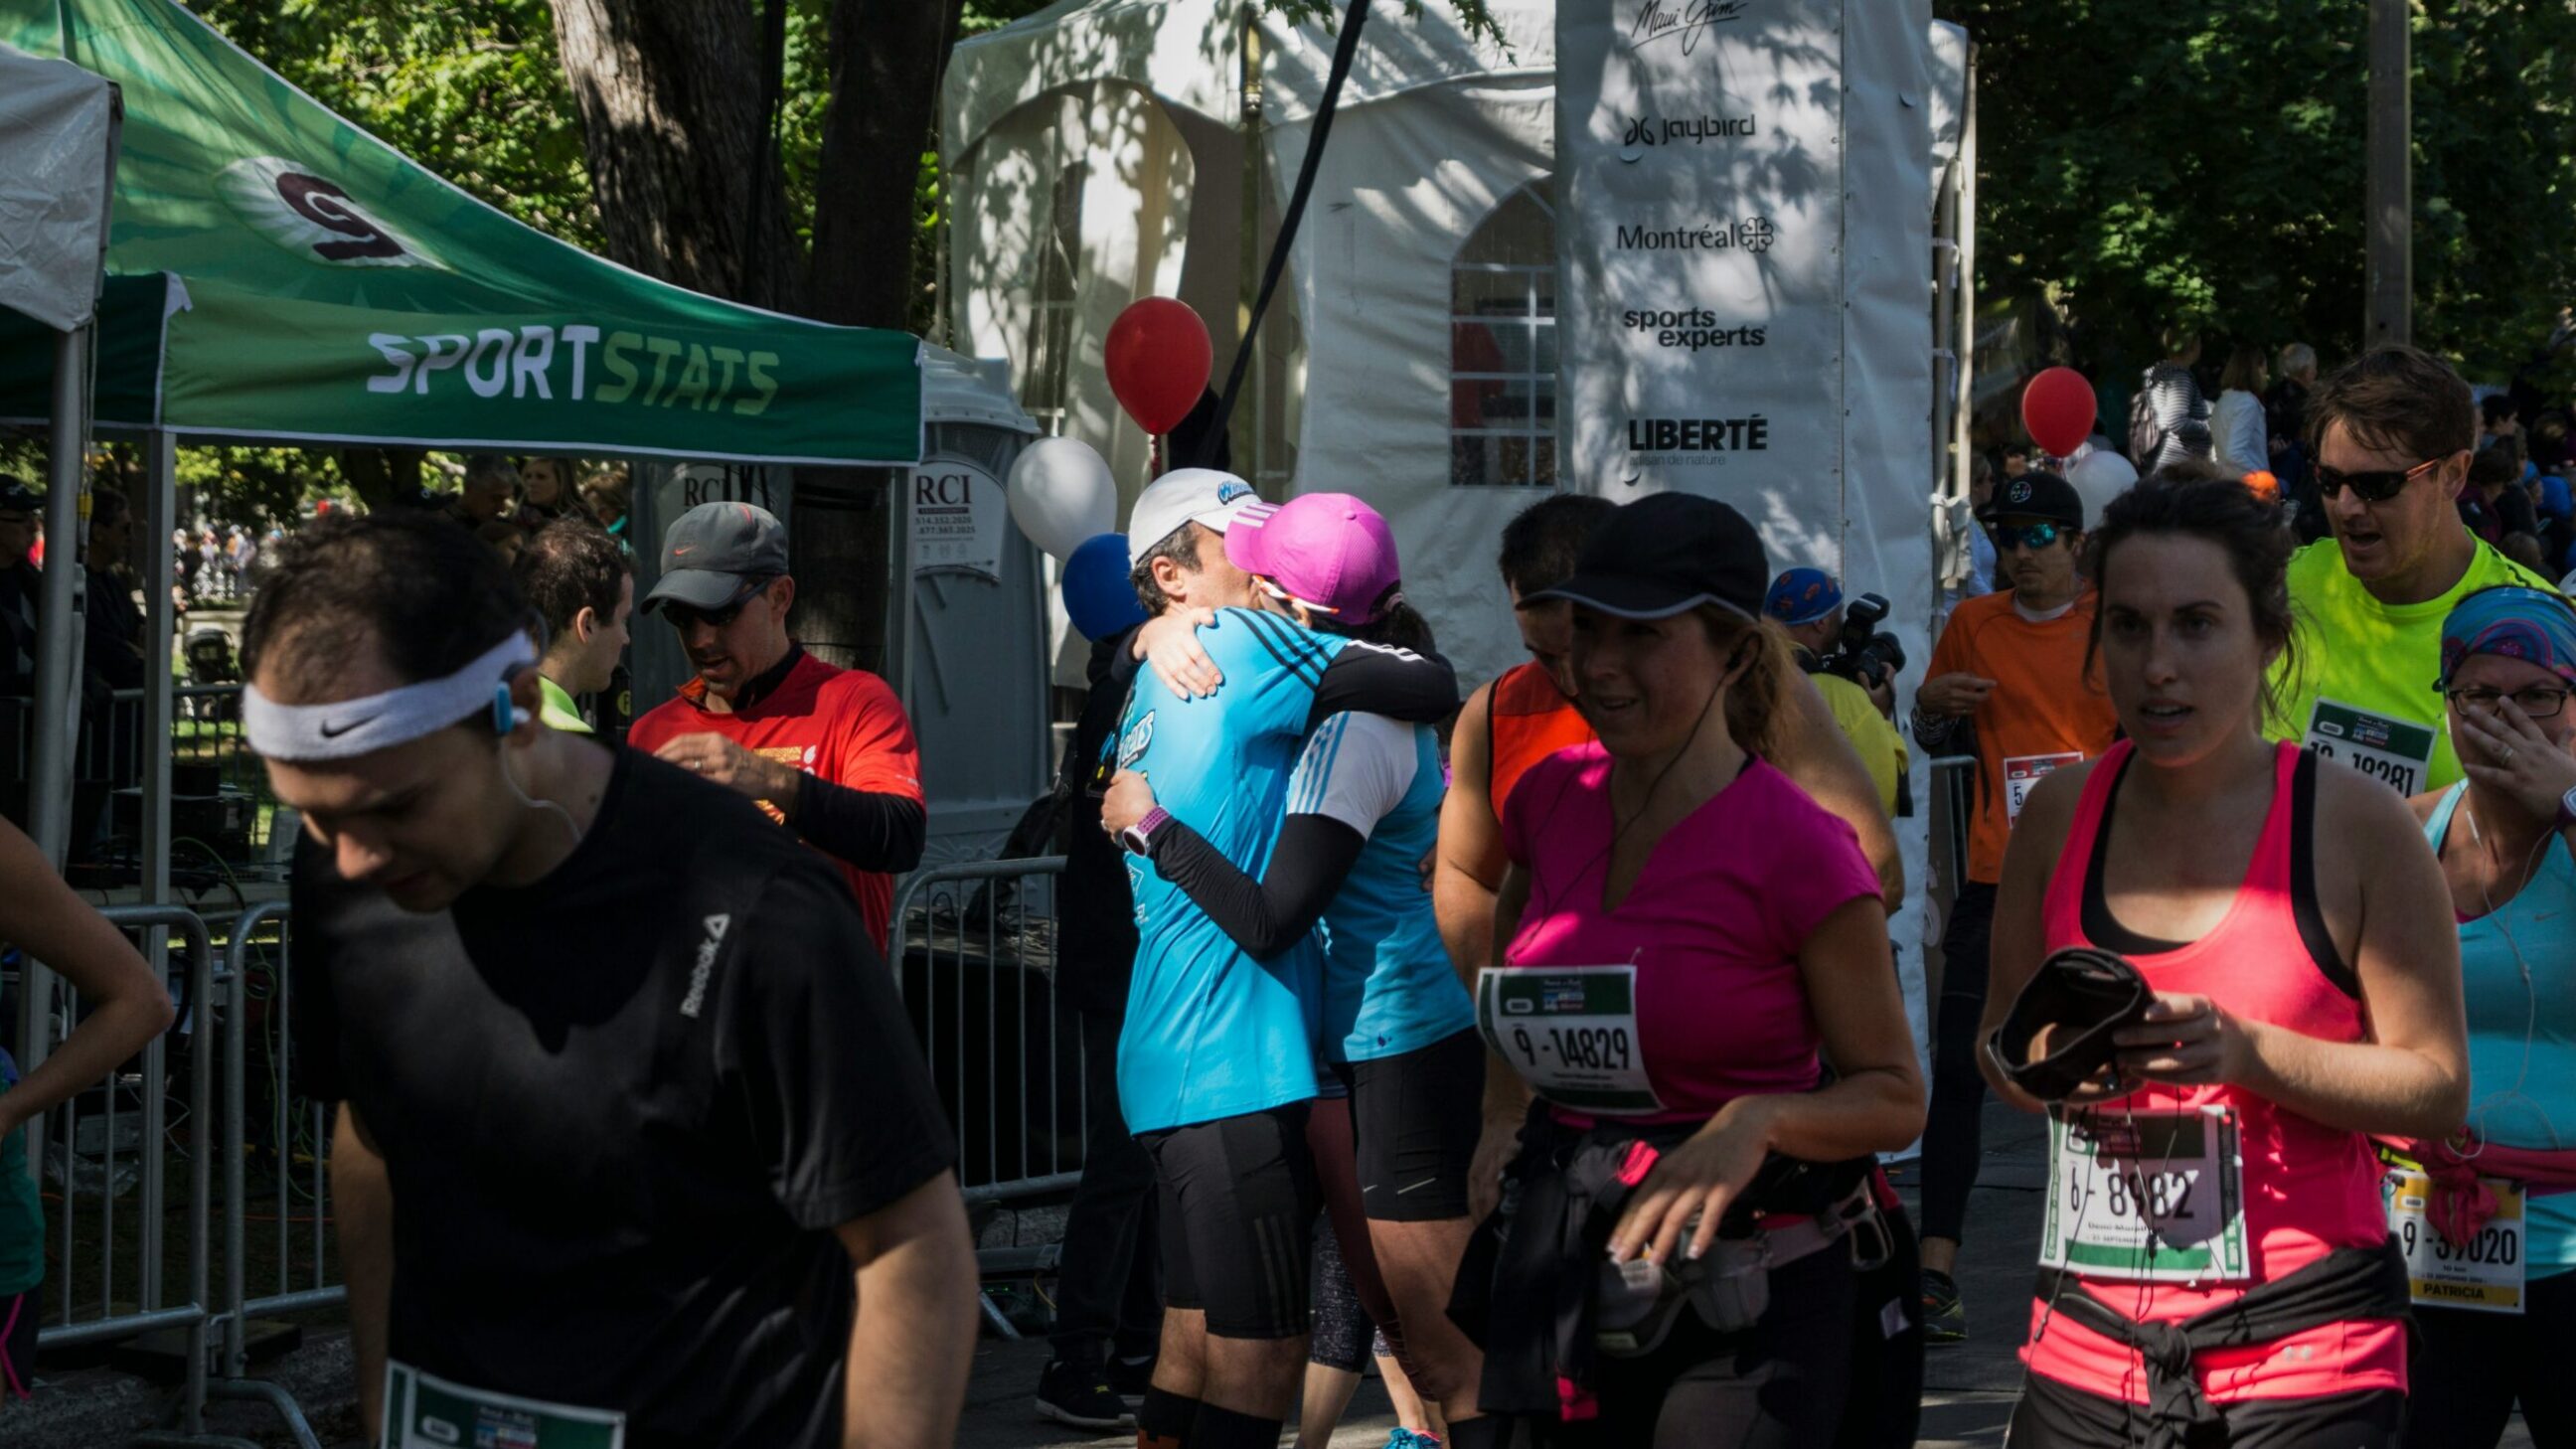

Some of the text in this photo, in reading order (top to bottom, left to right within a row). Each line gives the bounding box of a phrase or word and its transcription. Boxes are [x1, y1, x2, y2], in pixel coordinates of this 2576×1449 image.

[1662, 113, 1756, 146] jaybird
[1616, 223, 1736, 249] Montréal
[1623, 305, 1717, 333] sports
[1658, 324, 1766, 352] experts
[366, 324, 780, 416] SPORTSTATS
[1628, 412, 1769, 452] LIBERTÉ
[915, 474, 973, 506] RCI
[2013, 785, 2023, 806] 5
[2423, 1283, 2486, 1299] PATRICIA
